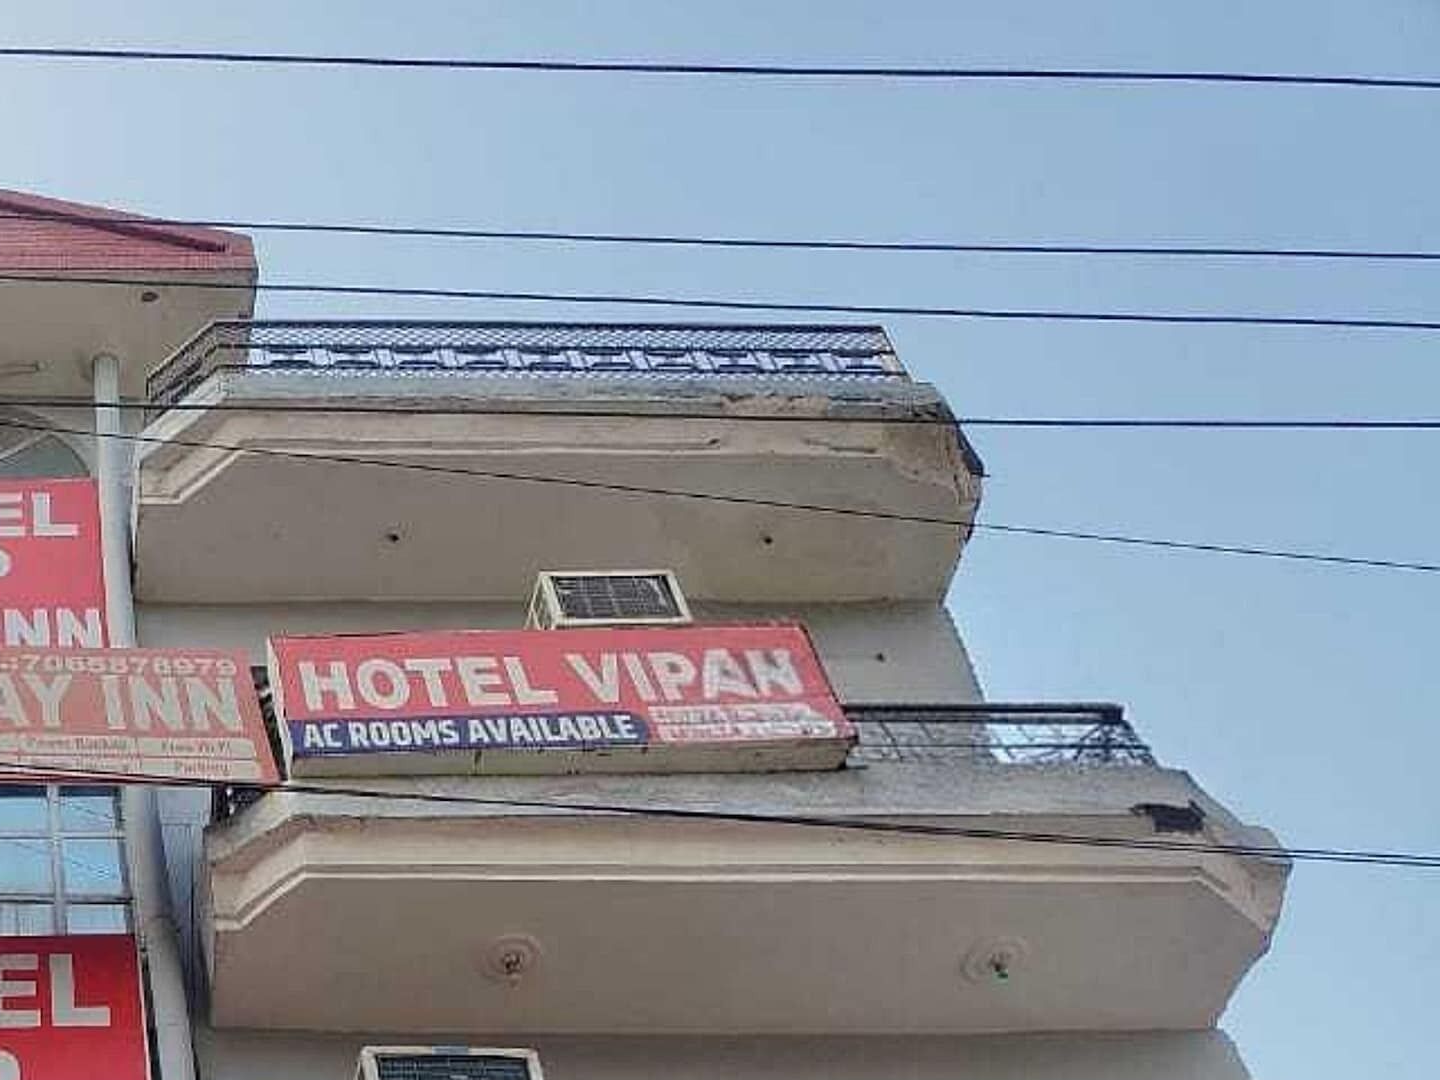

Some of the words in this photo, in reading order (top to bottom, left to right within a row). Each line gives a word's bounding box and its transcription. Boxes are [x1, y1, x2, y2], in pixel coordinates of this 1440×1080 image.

[102, 672, 244, 734] INN
[298, 654, 560, 711] HOTEL
[302, 721, 342, 748] AC
[349, 719, 458, 748] ROOMS
[468, 714, 639, 744] AVAILABLE
